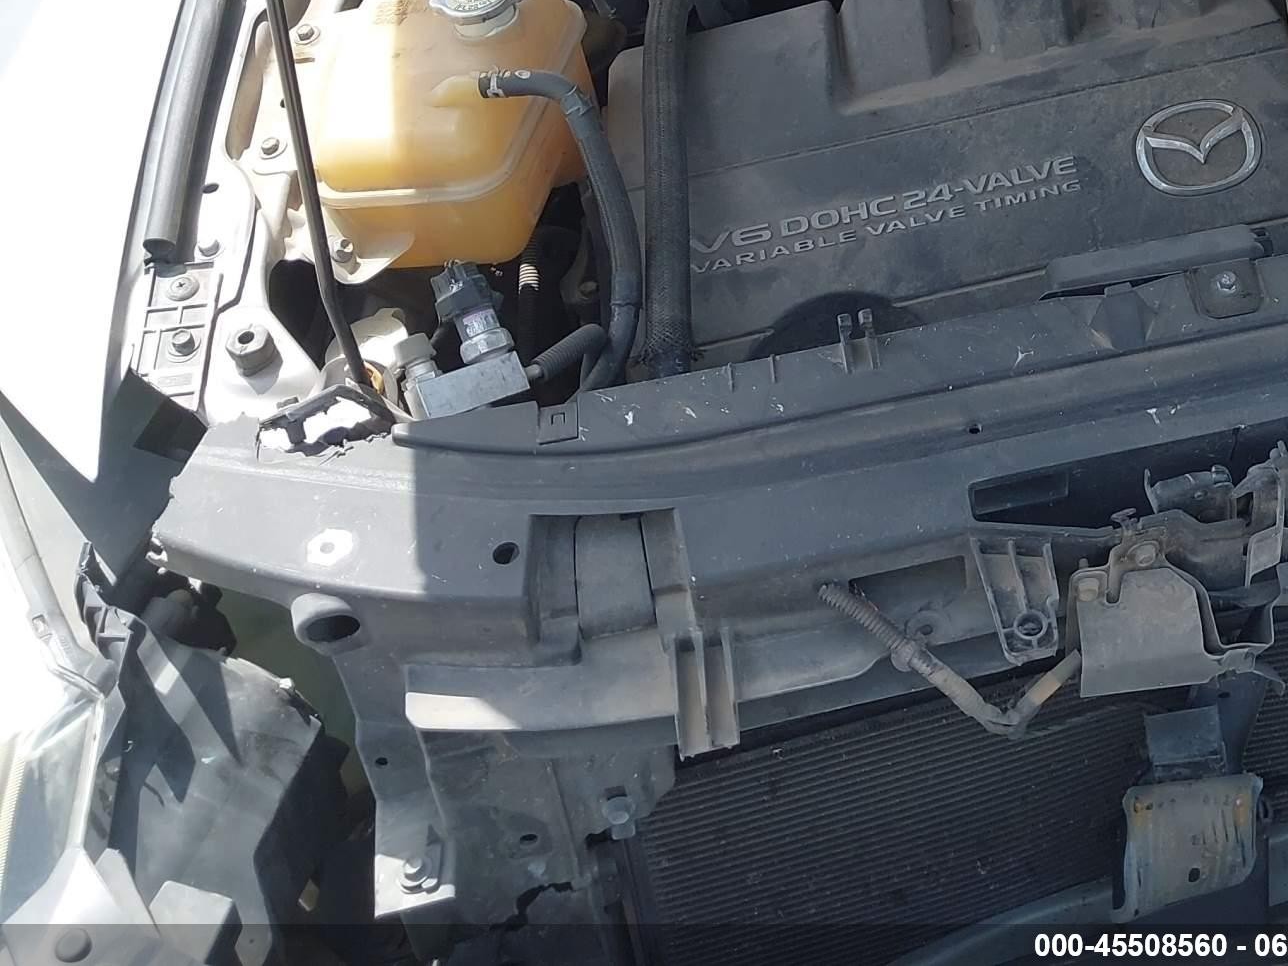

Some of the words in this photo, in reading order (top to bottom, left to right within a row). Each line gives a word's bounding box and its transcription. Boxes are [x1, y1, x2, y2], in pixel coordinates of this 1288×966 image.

[689, 222, 773, 254] V6
[780, 195, 898, 236] DOHC
[901, 155, 1077, 211] 24-VALVE
[690, 230, 857, 274] VARIABLE
[866, 204, 966, 236] VALVE
[974, 179, 1082, 212] TIMING
